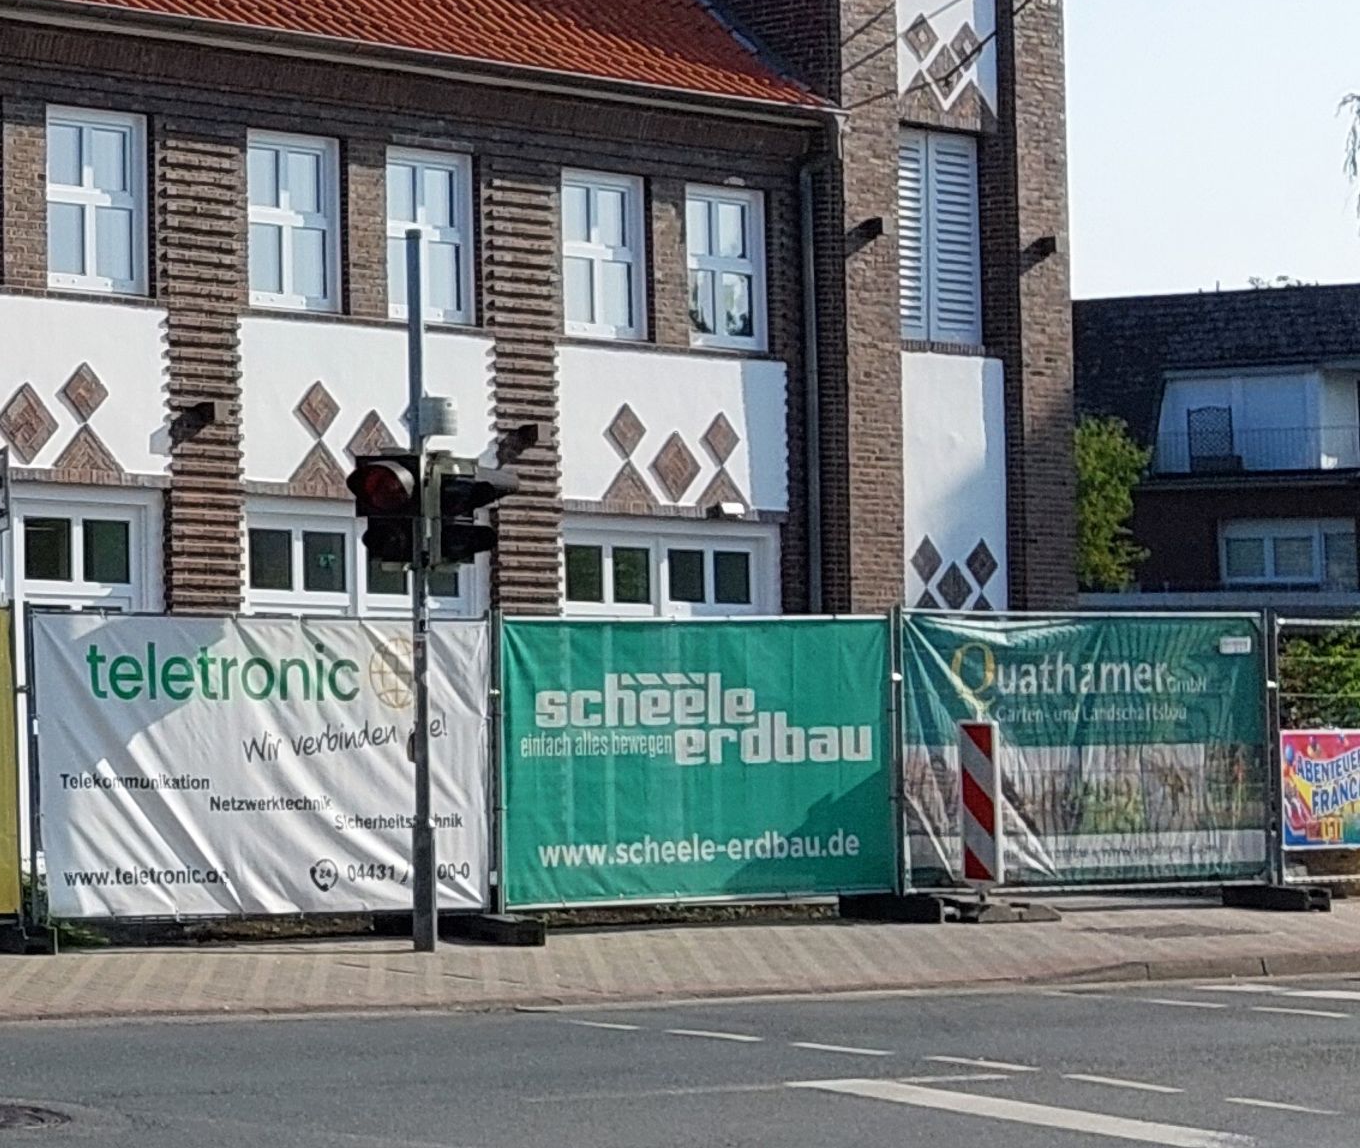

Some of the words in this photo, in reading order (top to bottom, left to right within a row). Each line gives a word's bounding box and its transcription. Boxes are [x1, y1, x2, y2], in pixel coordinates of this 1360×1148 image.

[86, 642, 360, 702] teletronic
[951, 642, 1168, 708] Quathamer
[1167, 677, 1207, 692] GmbH
[535, 672, 756, 728] scheele
[996, 705, 1049, 723] Garten-
[1056, 704, 1079, 722] und
[1082, 703, 1188, 723] Landschaftsbau
[243, 731, 282, 763] Wir
[291, 720, 398, 756] verbinden
[520, 731, 572, 758] einfach
[575, 730, 609, 756] alles
[611, 730, 673, 758] bewegen
[675, 711, 873, 765] erdbau
[60, 773, 210, 791] Telekommunikation
[1312, 776, 1360, 815] FRANC
[210, 796, 333, 812] Netzwerktechnik
[335, 812, 463, 830] Sicherheitshnik
[538, 828, 861, 868] www.scheele-erdbau.de
[319, 868, 331, 879] 24
[347, 863, 395, 882] 04431
